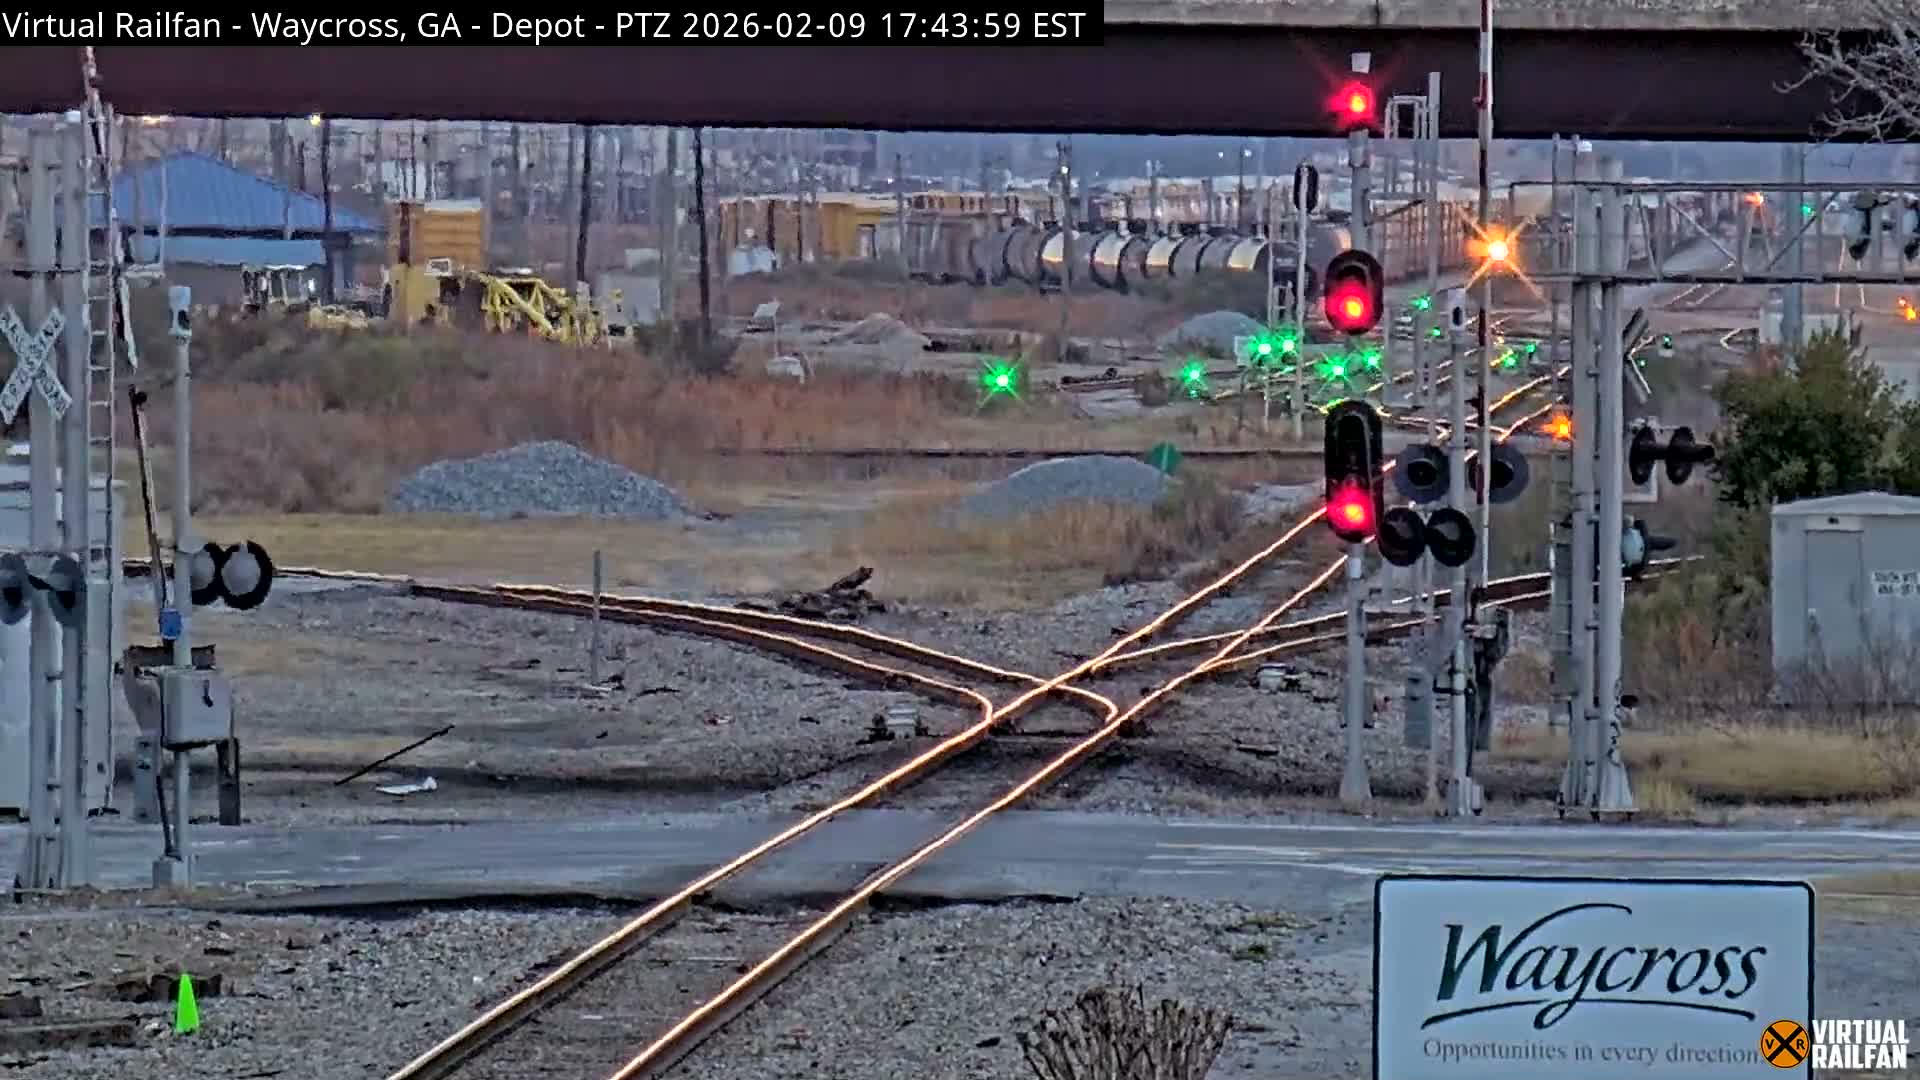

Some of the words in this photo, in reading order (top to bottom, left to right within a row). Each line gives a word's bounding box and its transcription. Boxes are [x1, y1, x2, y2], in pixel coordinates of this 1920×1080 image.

[1437, 903, 1767, 1030] Waycross
[1423, 1039, 1567, 1063] Opportunities
[1575, 1042, 1593, 1061] in
[1601, 1045, 1658, 1067] every
